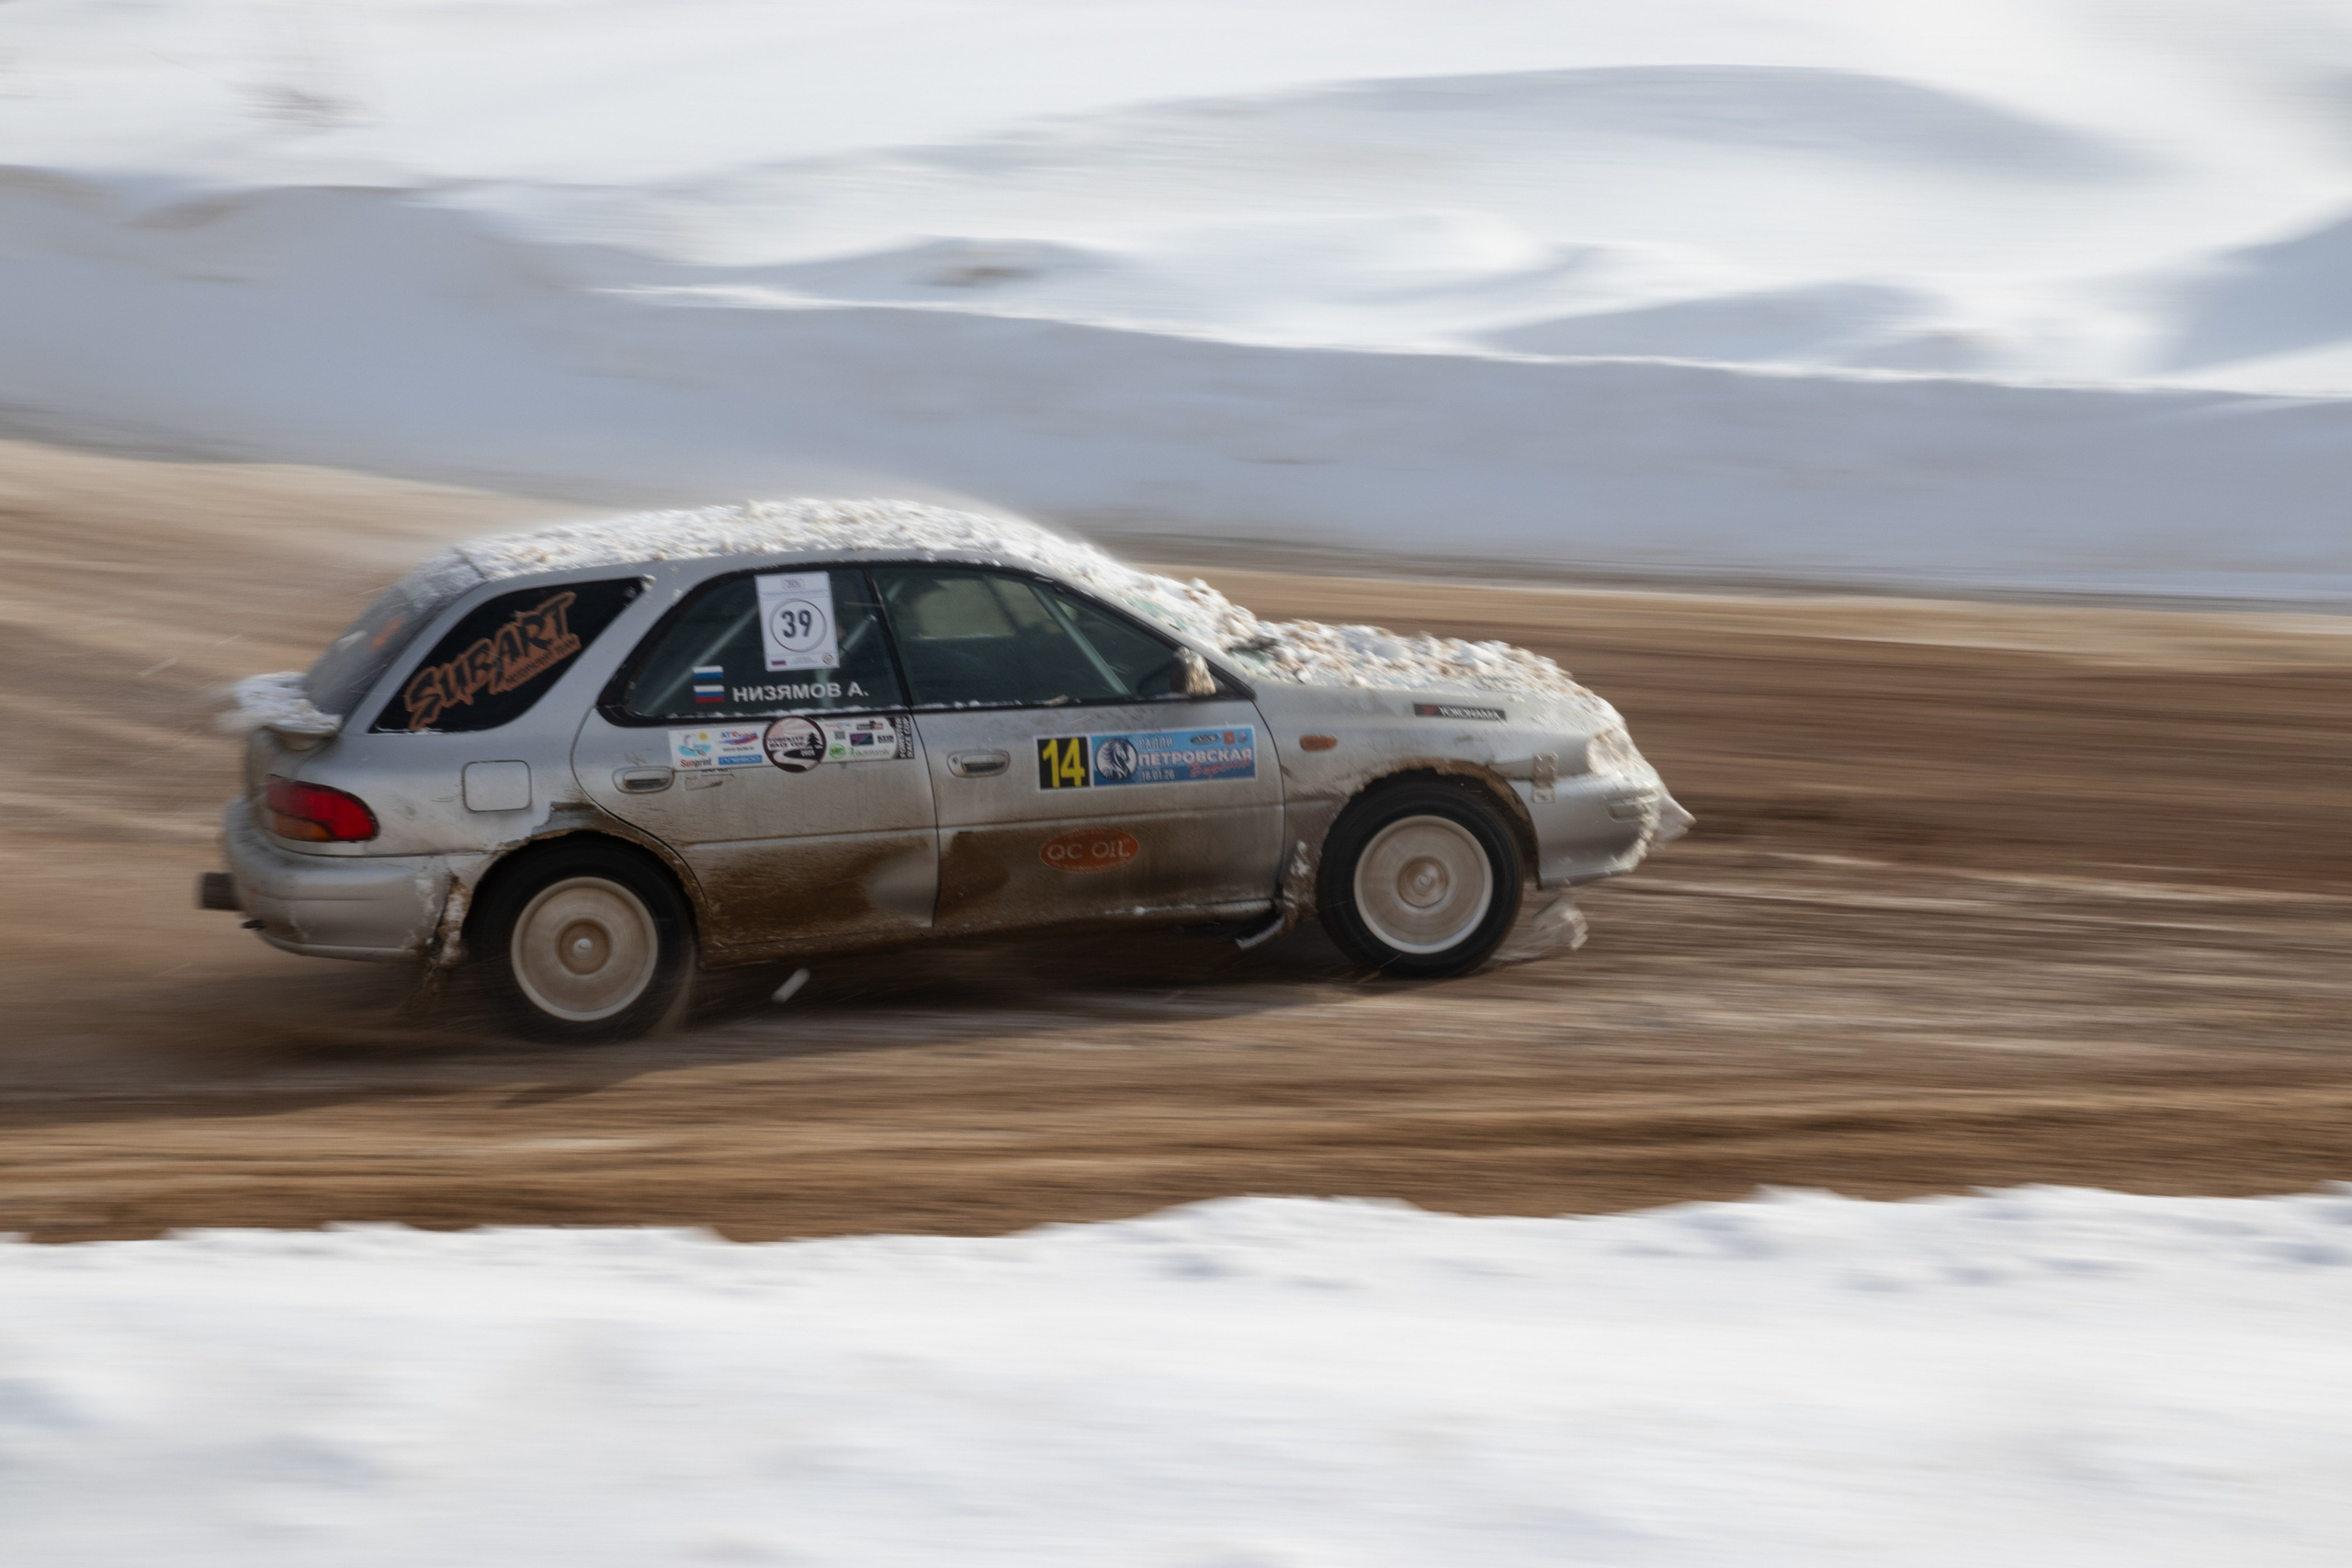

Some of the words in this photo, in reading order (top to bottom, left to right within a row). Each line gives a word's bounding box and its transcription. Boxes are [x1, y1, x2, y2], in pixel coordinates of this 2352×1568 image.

[781, 610, 812, 638] 39
[732, 682, 842, 702] НИЗЯМОВ
[847, 681, 869, 697] А.
[1137, 736, 1173, 749] РАЛЛИ
[681, 757, 713, 768] Sunprint
[1042, 738, 1085, 788] 14
[1138, 747, 1252, 767] ПЕТРОВСКАЯ
[1047, 844, 1083, 860] QC
[1091, 840, 1131, 859] OIL
